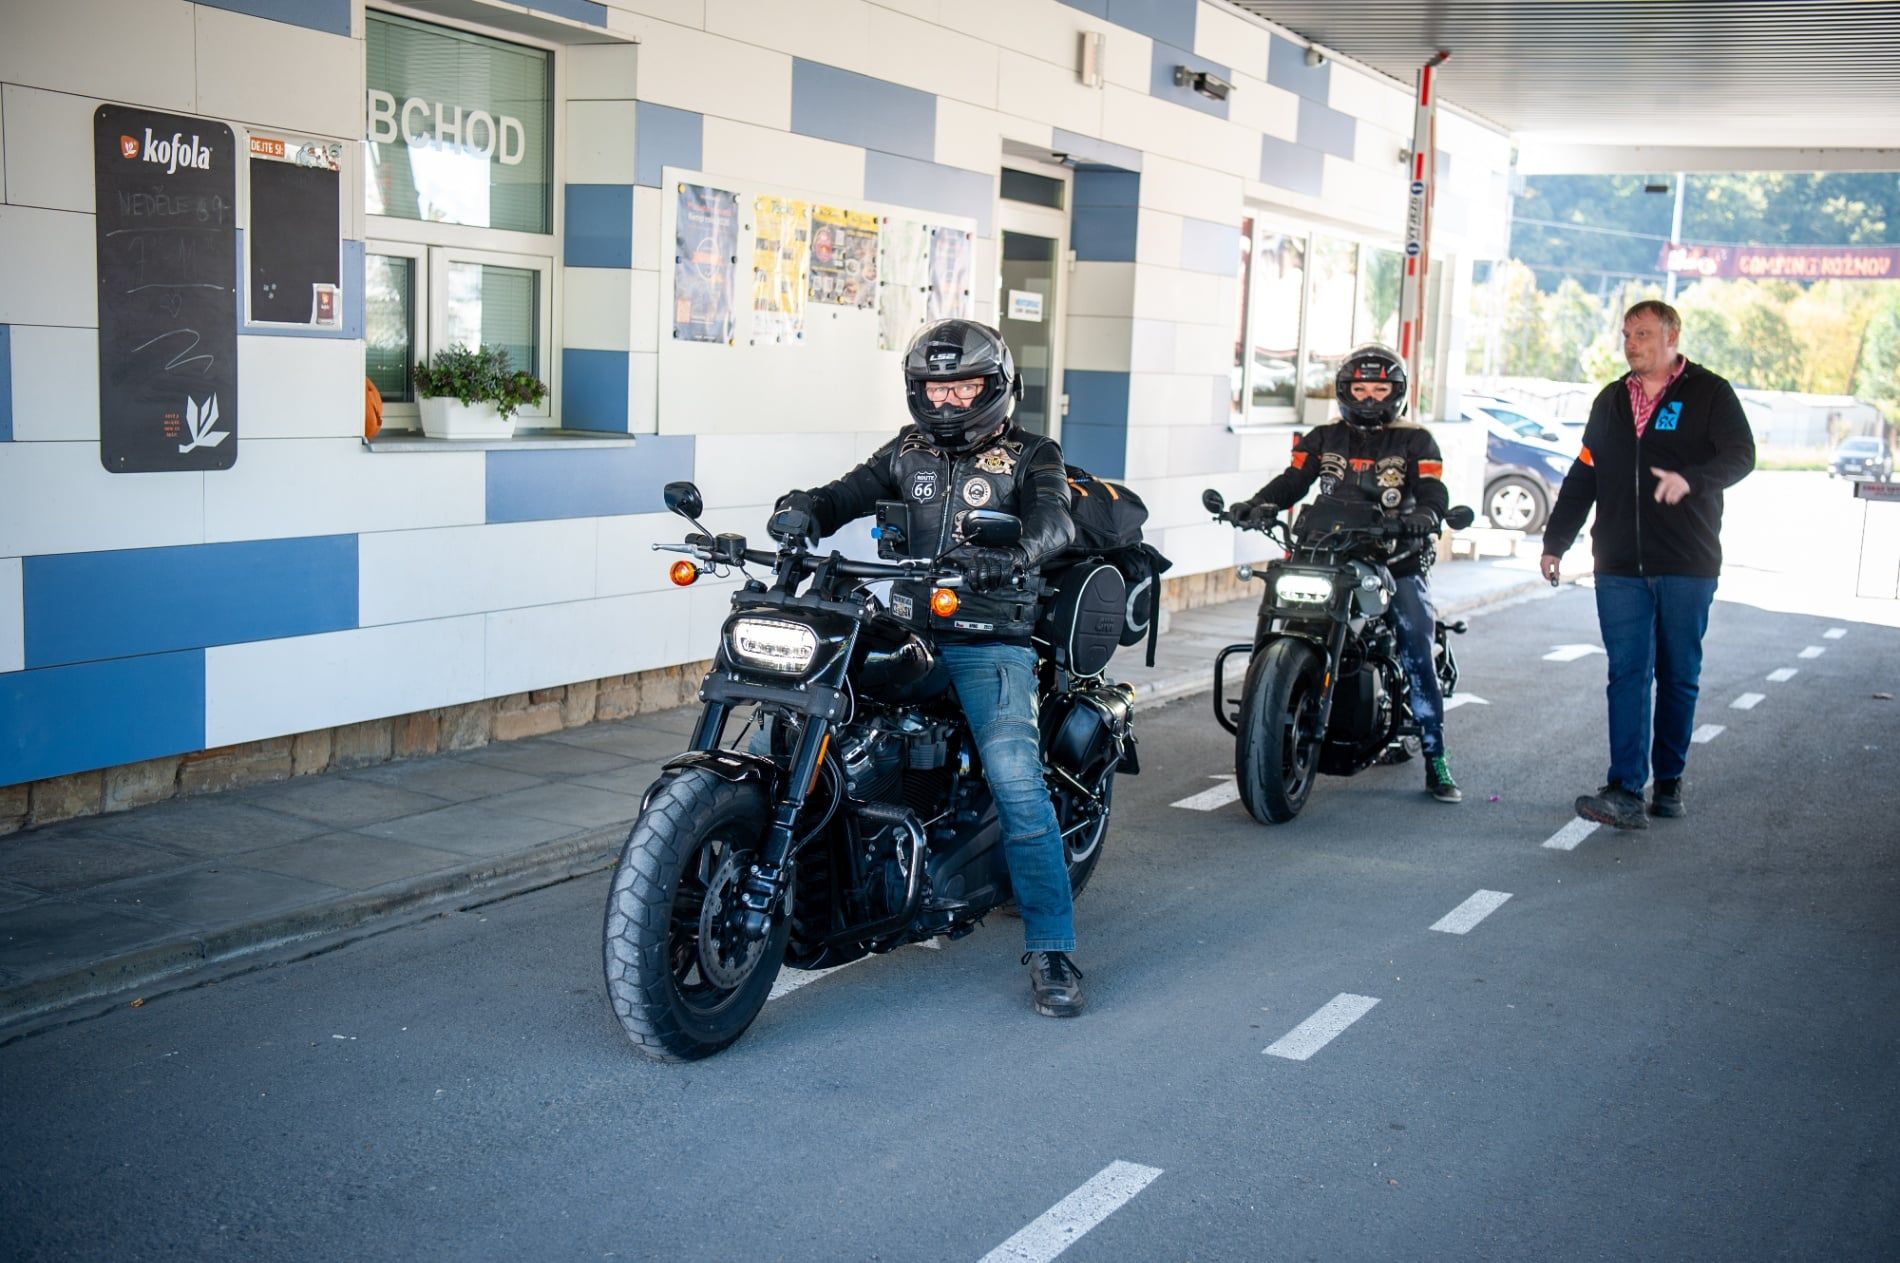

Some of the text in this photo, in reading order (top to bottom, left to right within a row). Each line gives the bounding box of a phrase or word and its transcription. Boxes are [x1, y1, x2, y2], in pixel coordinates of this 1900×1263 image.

[142, 128, 211, 175] kofola
[251, 139, 273, 153] DEJTE
[929, 353, 956, 361] LS2
[914, 483, 933, 497] 66
